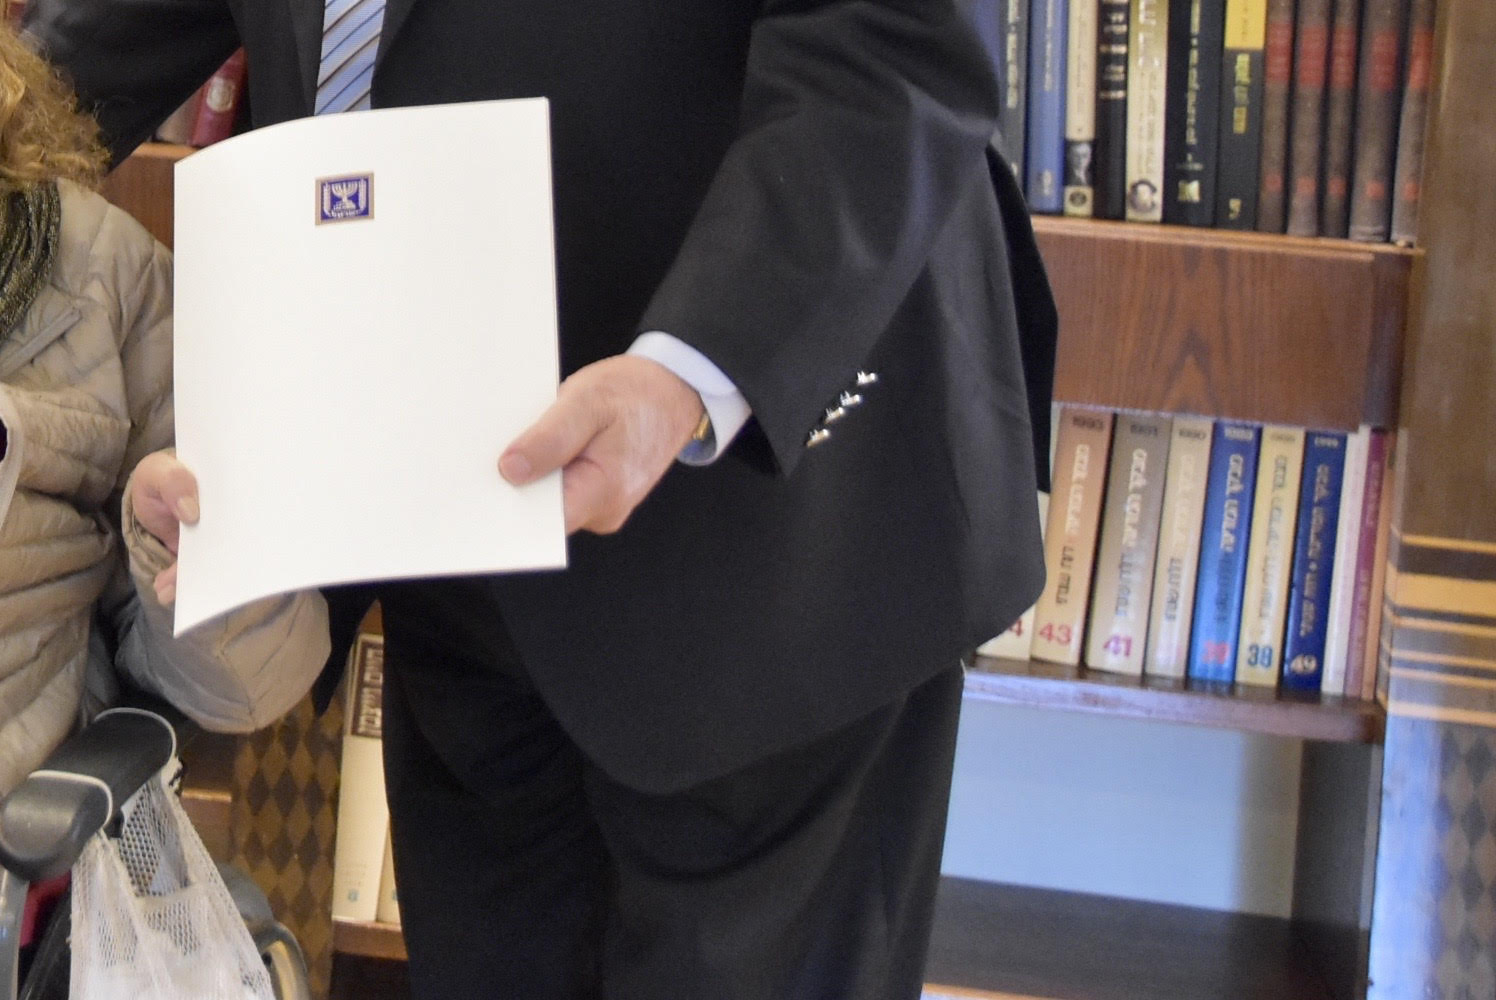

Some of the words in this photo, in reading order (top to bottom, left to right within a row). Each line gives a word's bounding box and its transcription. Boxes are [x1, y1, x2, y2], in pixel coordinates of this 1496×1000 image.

[1039, 622, 1073, 646] 43
[1103, 635, 1133, 659] 41
[1246, 643, 1274, 669] 38
